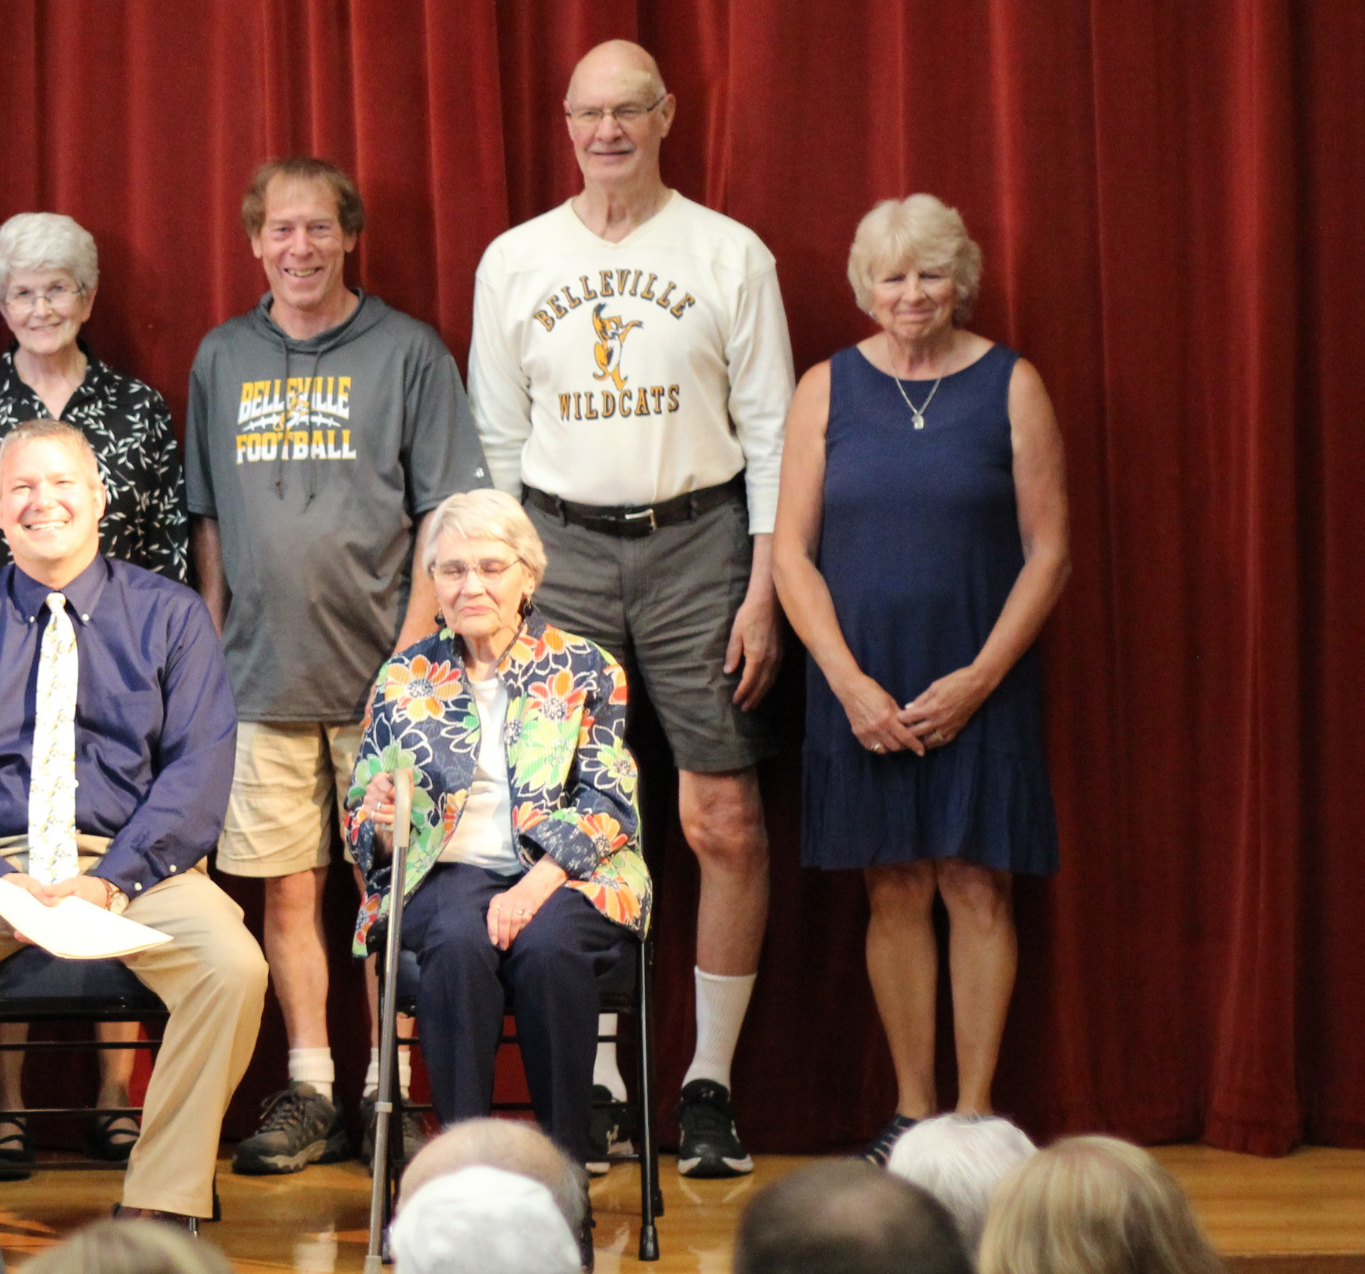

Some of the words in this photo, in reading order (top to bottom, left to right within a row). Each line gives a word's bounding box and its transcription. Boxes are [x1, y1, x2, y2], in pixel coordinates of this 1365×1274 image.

[533, 269, 696, 332] BELLEVILLE
[237, 376, 352, 425] BELLEVILLE
[558, 384, 680, 422] WILDCATS
[236, 429, 357, 465] FOOTBALL
